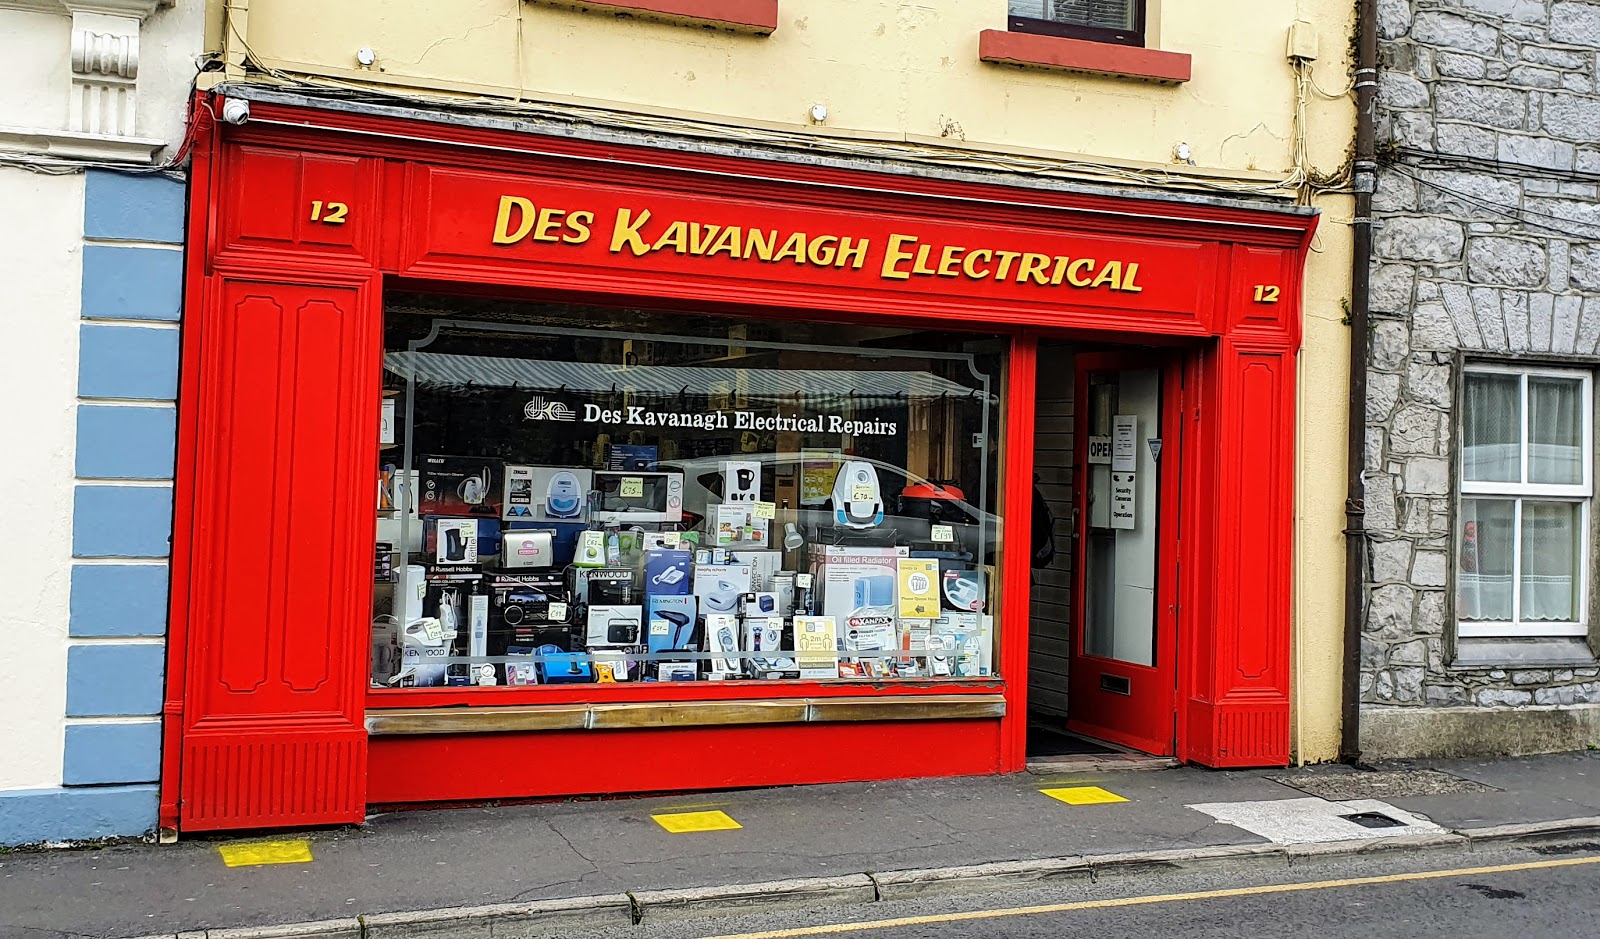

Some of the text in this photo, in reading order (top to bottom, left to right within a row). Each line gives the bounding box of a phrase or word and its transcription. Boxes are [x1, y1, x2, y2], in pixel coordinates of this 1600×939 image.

[311, 201, 348, 223] 12
[493, 195, 1142, 293] DES KAVANAGH ELECTRICAL
[1254, 285, 1280, 304] 12
[583, 403, 897, 437] Des Kavanagh Electrical Repairs
[1115, 487, 1131, 495] Security
[1113, 511, 1133, 519] Operation
[468, 539, 477, 563] kettle
[831, 556, 893, 565] Oil filled Radiator
[851, 617, 890, 626] PAXANPAX
[404, 649, 445, 657] KENOOD
